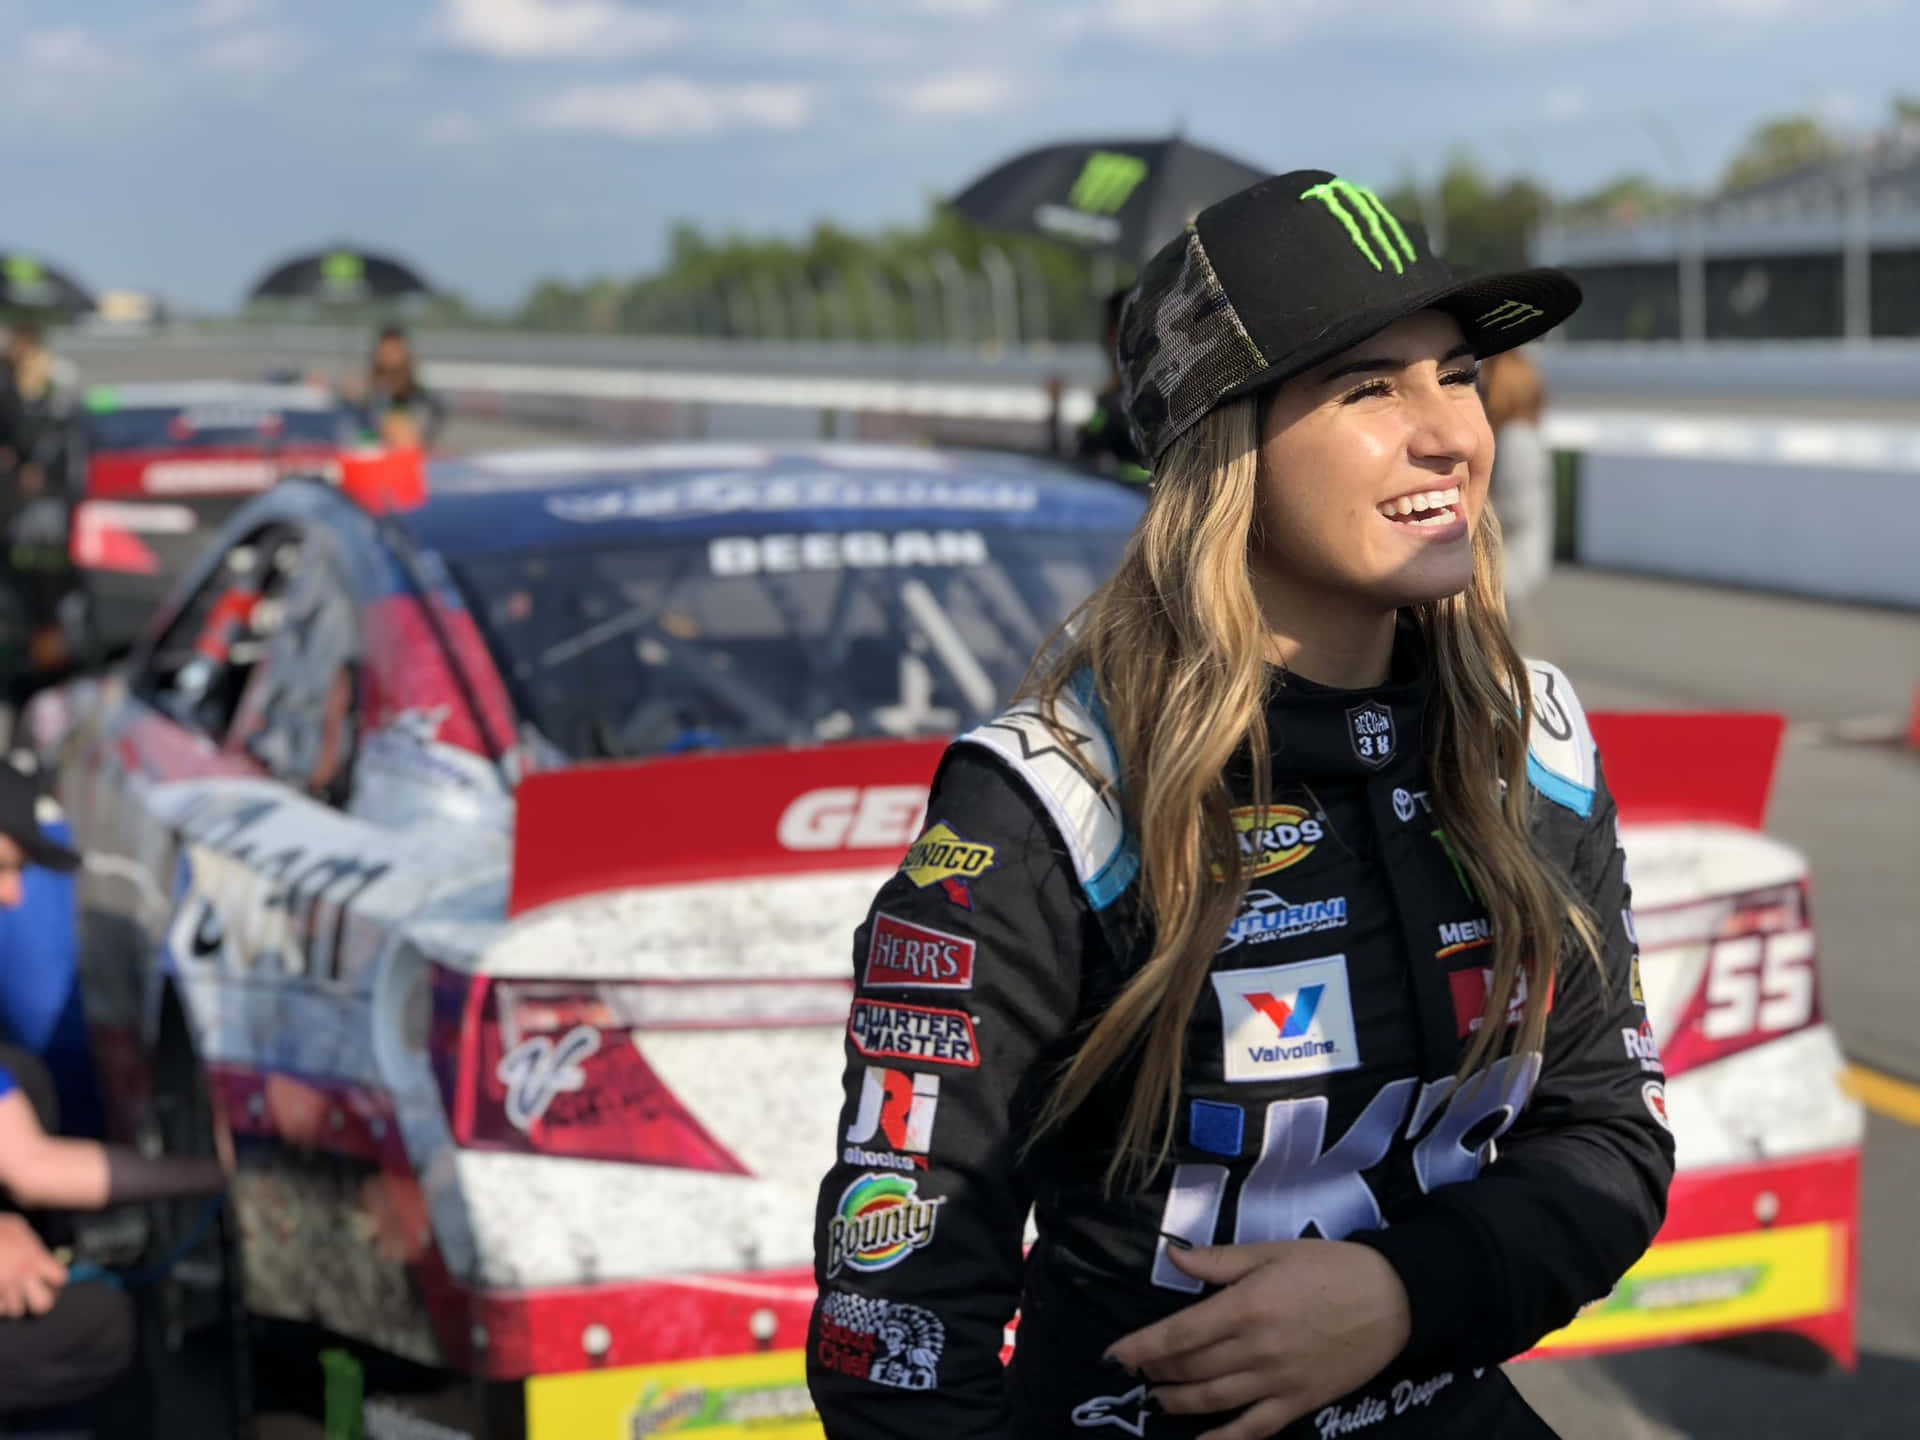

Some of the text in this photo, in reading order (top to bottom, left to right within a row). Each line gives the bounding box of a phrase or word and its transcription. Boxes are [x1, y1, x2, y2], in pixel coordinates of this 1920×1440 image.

[709, 530, 987, 577] DEEGAN
[1358, 735, 1390, 756] 38
[873, 932, 959, 980] HERR'S
[1703, 933, 1815, 1041] 55
[854, 1003, 966, 1040] QUARTER
[864, 1026, 971, 1061] MASTER
[827, 1199, 938, 1280] Bounty
